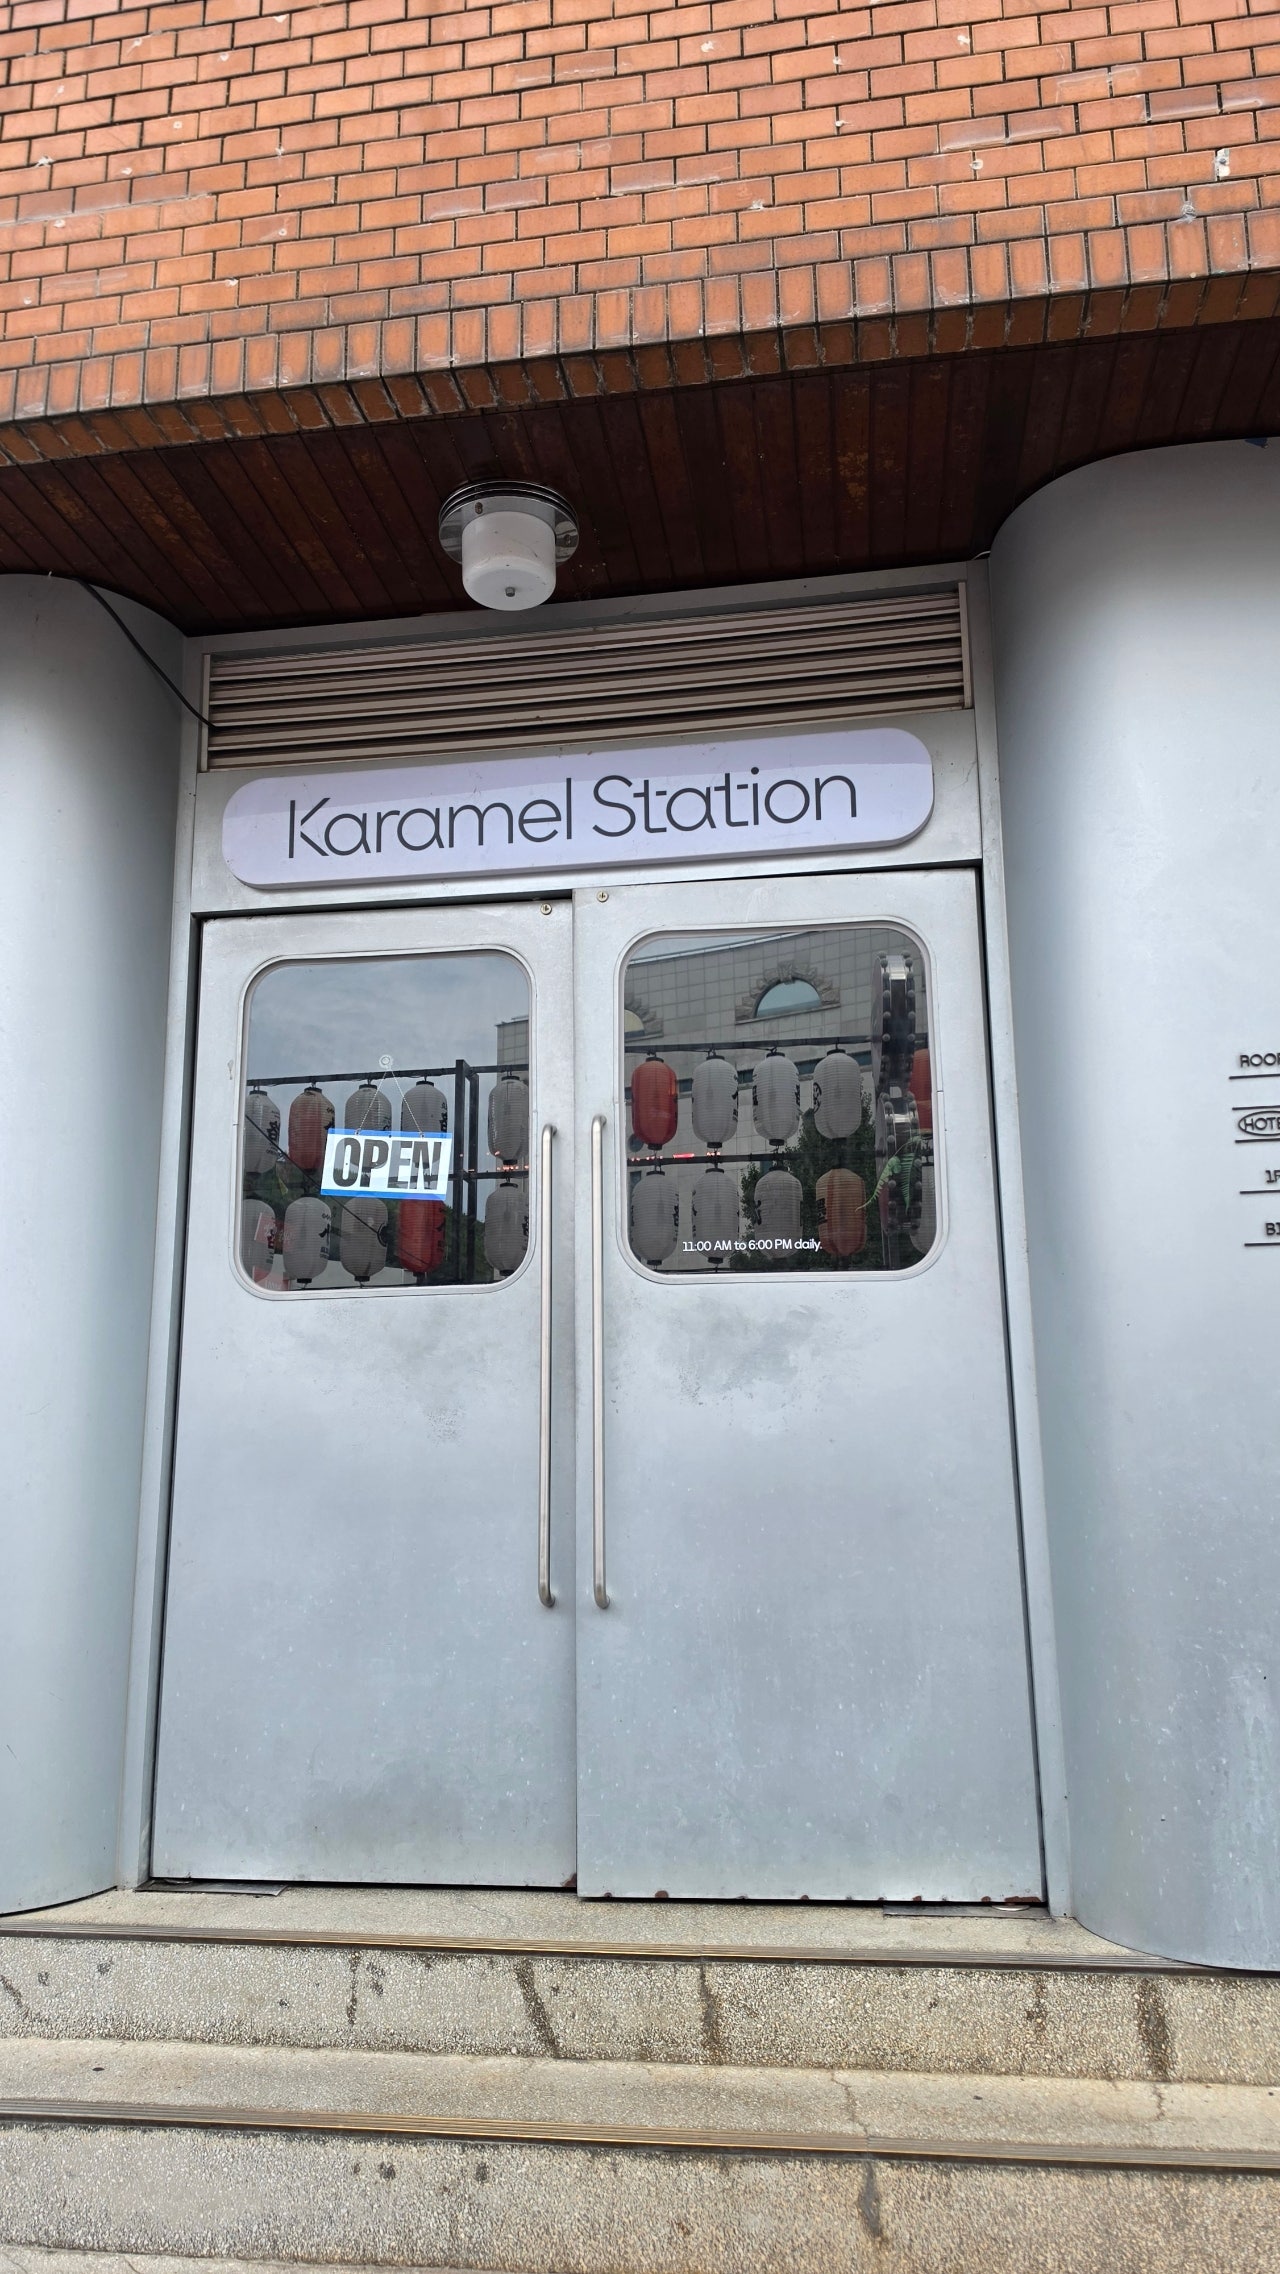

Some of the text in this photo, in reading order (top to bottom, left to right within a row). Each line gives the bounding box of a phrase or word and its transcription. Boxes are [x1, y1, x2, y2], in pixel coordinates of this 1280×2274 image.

[288, 766, 858, 859] Karamel Station
[332, 1137, 442, 1191] OPEN
[682, 1237, 823, 1252] 11:00 AM to 6:00 PM daily.
